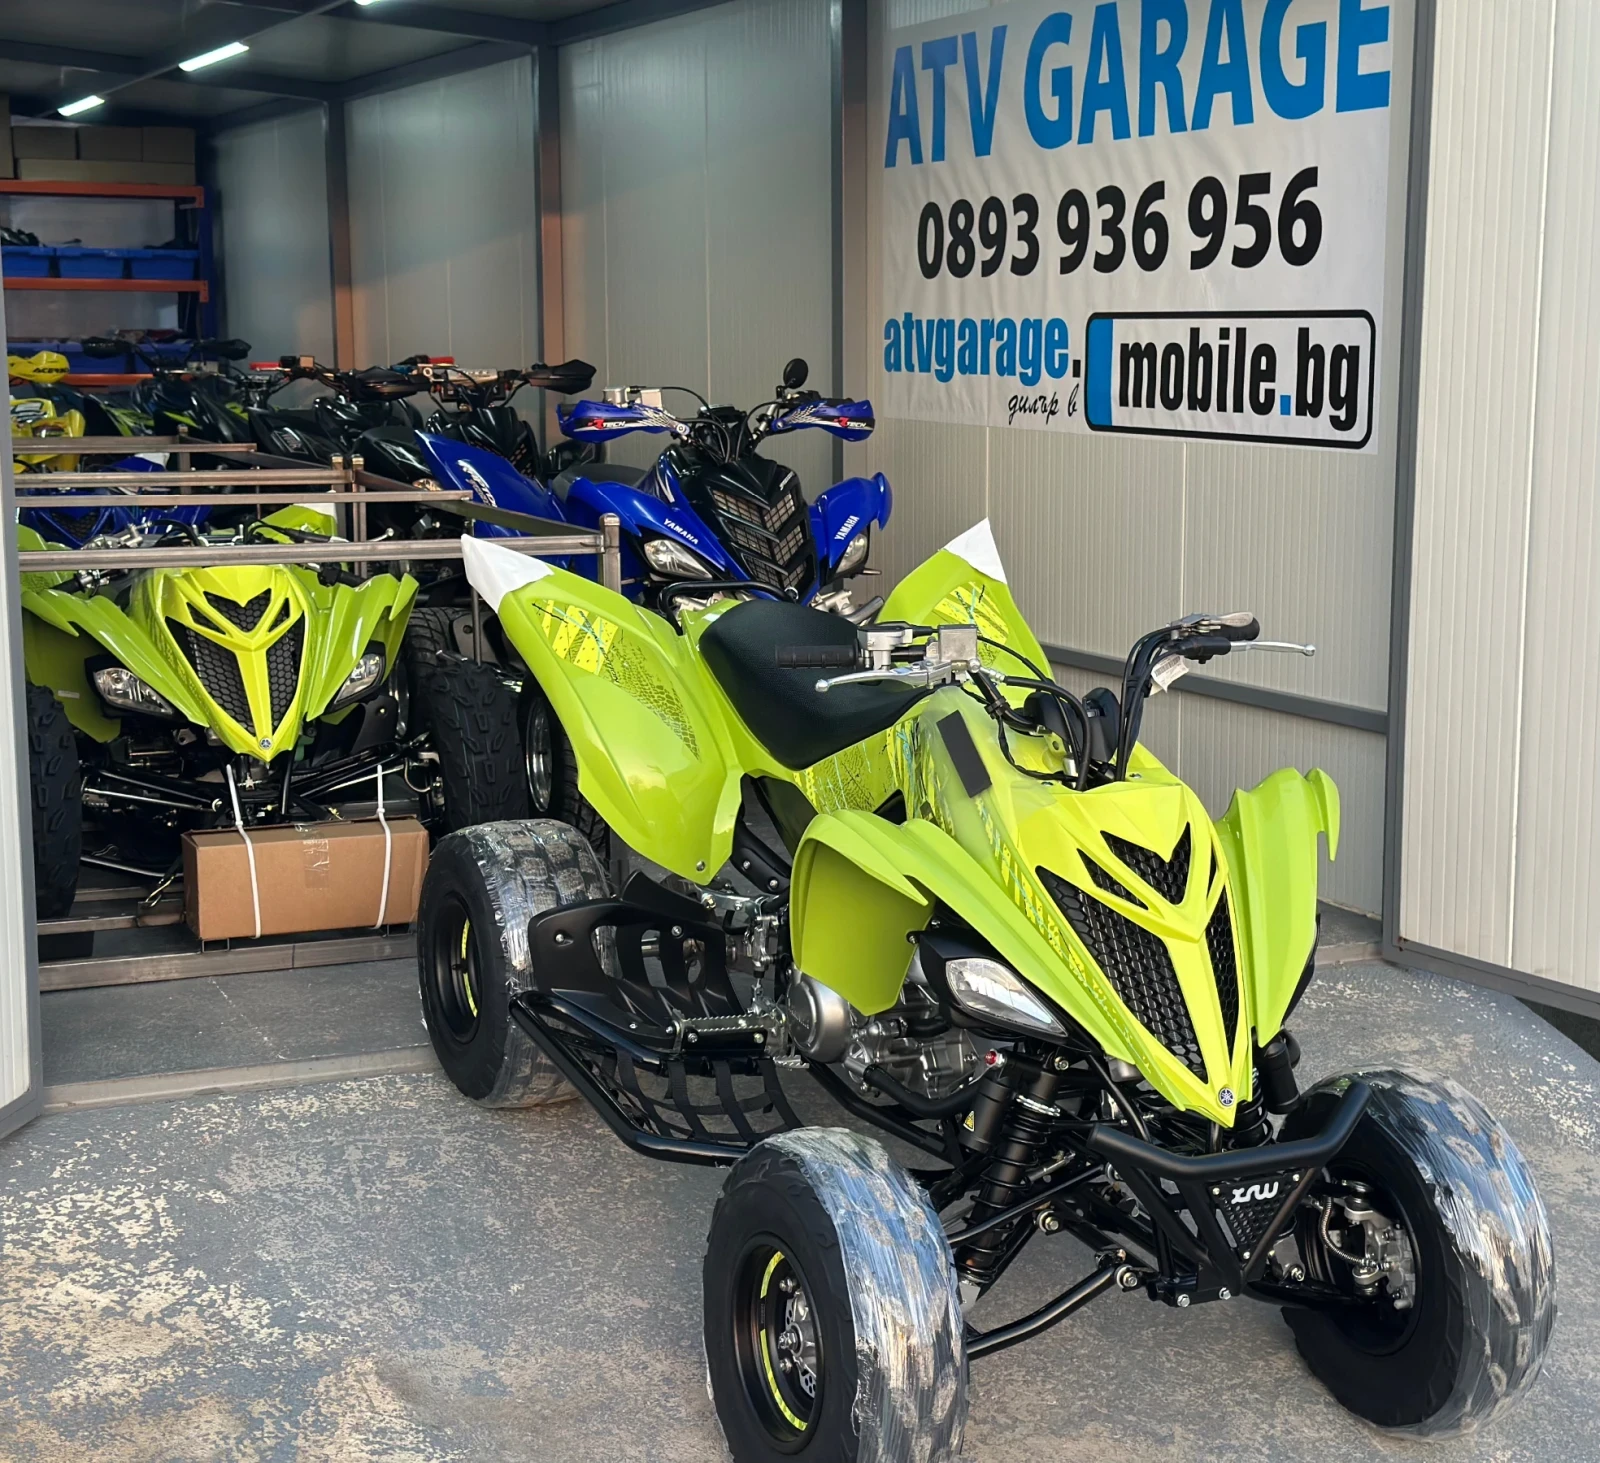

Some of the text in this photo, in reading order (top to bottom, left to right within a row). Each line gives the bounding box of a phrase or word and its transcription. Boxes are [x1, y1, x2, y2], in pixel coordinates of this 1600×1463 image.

[884, 0, 1391, 169] ATV GARAGE
[917, 166, 1323, 279] 0893 936 956
[1119, 327, 1361, 432] mobile.bg
[663, 518, 699, 545] YAMAHA
[833, 514, 860, 541] YAMAHA
